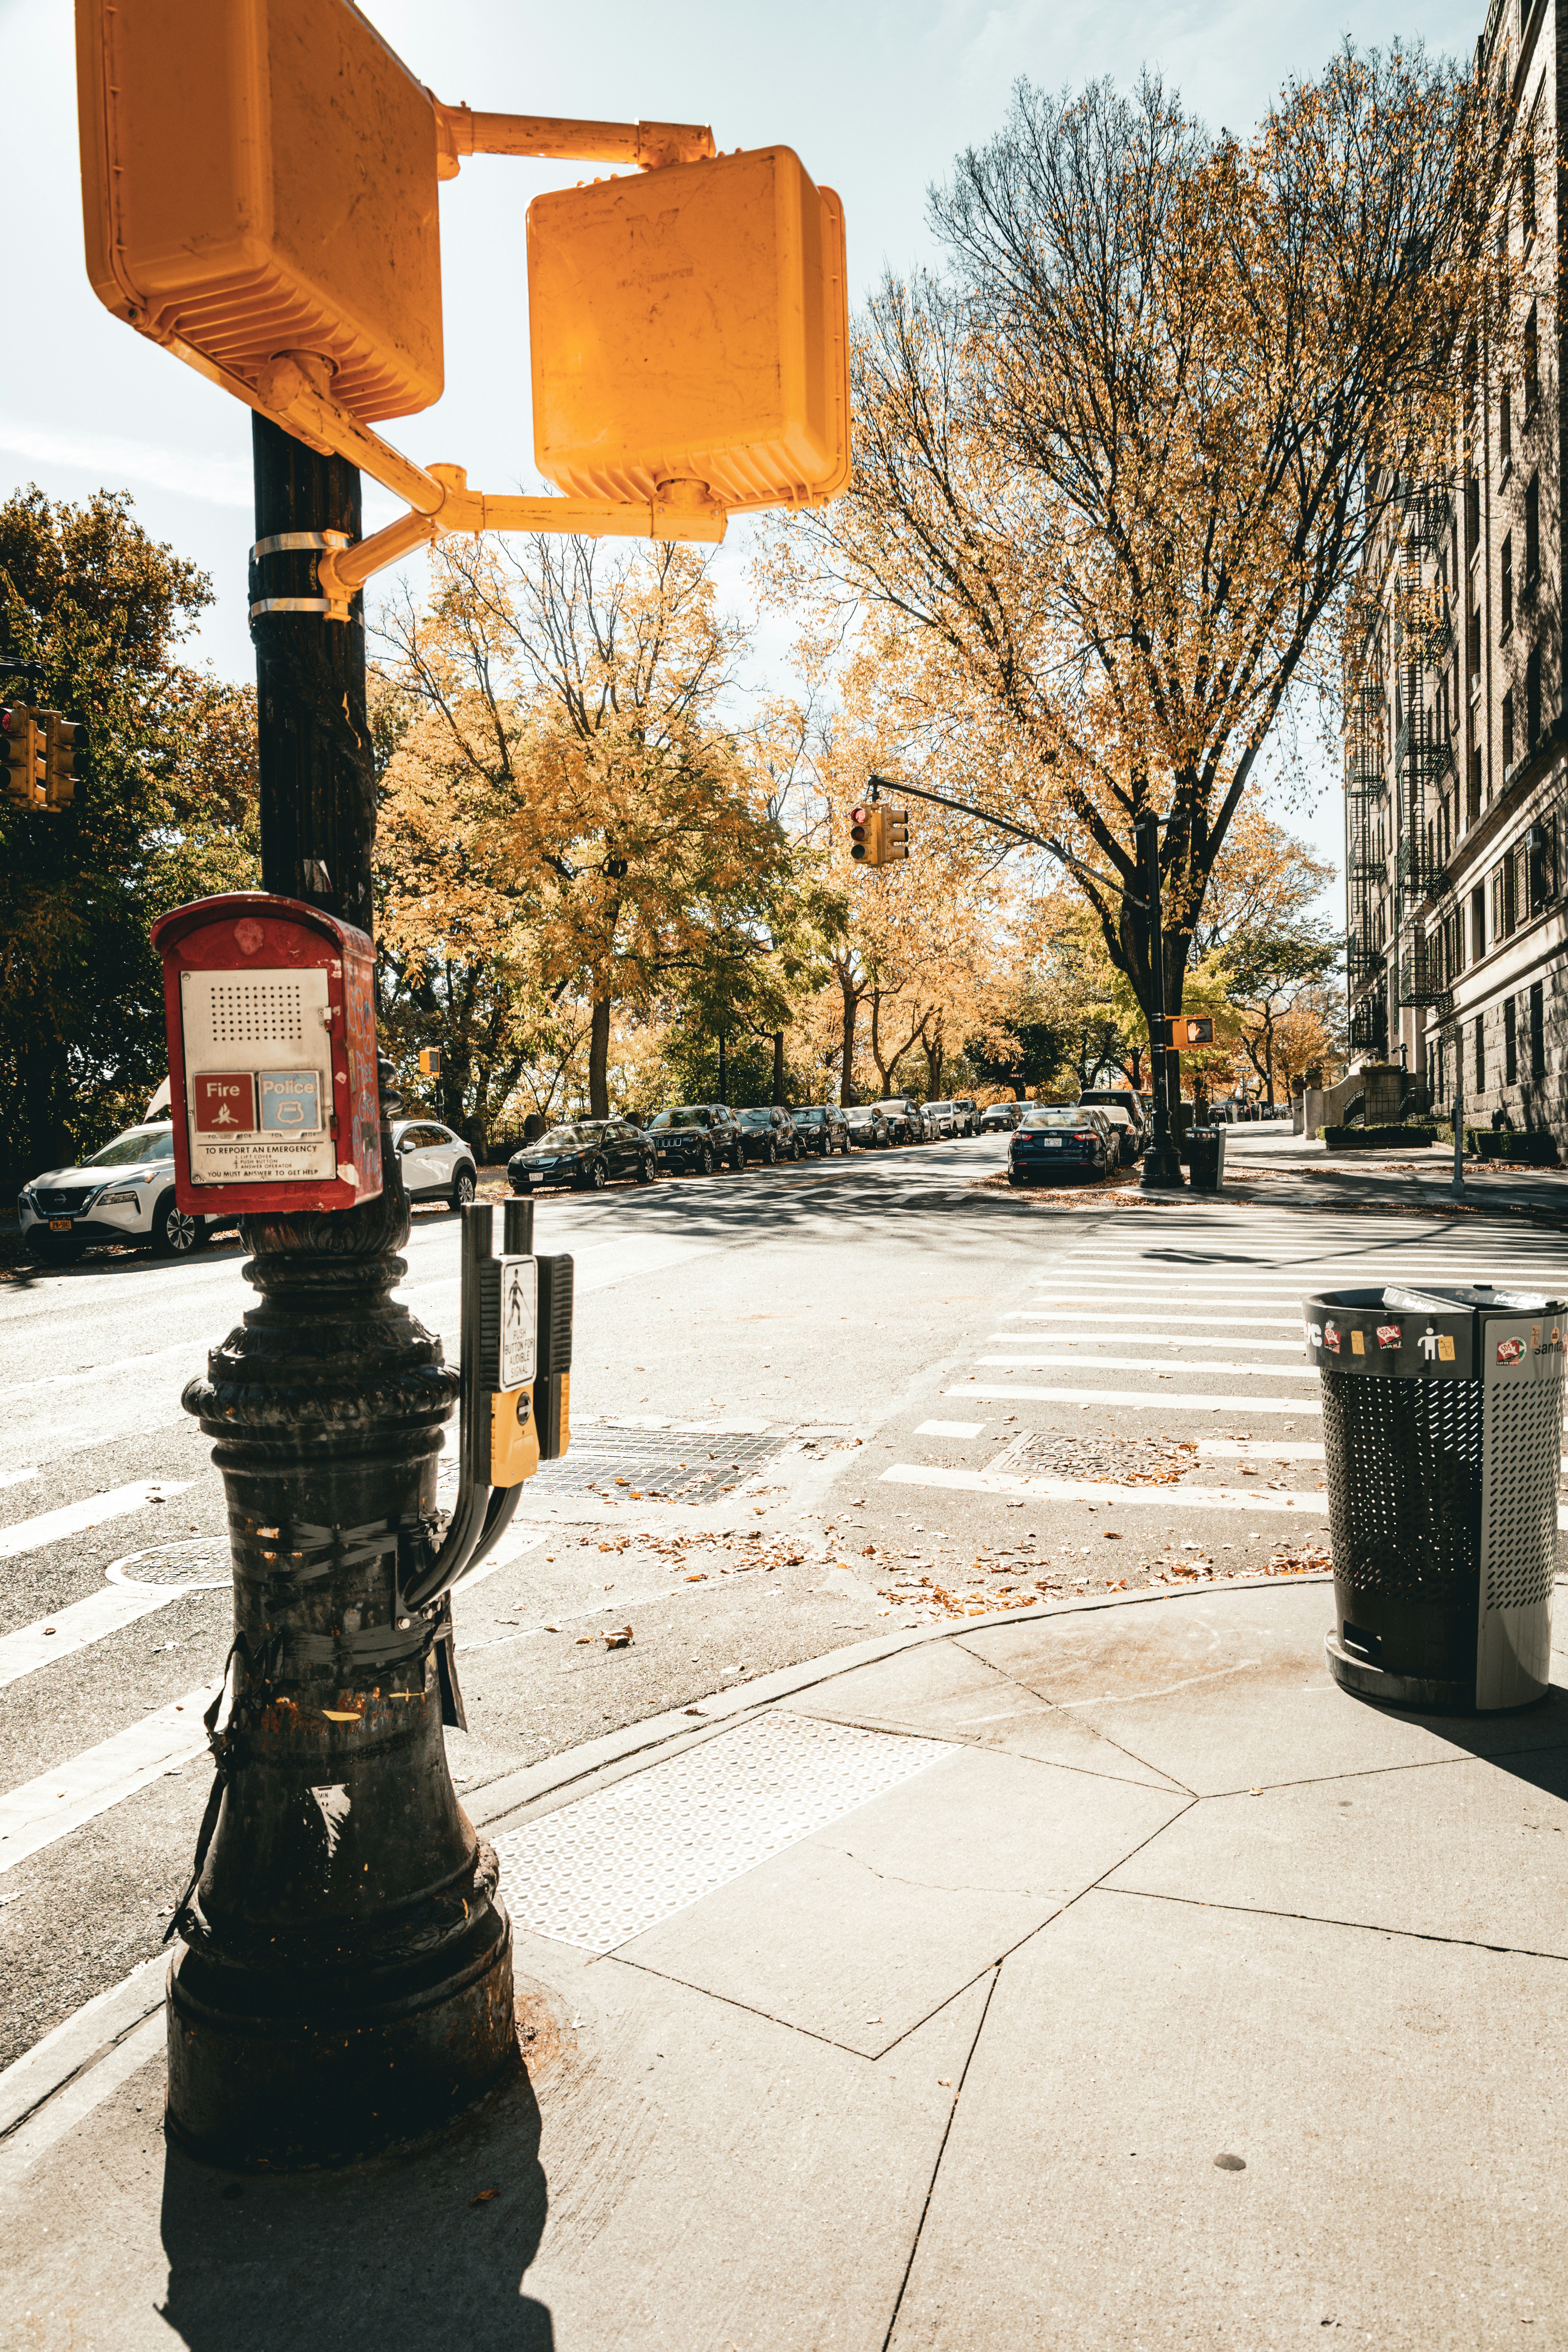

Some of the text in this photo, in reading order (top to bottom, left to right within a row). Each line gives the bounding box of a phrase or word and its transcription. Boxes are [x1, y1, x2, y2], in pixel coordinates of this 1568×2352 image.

[207, 1083, 240, 1097] Fire
[262, 1080, 315, 1095] Police
[513, 1328, 526, 1340] PUSH
[1379, 1328, 1391, 1337] SDS
[505, 1338, 534, 1355] BUTTON FOR
[1501, 1344, 1511, 1353] SDS
[509, 1351, 529, 1366] AUDIBLE
[511, 1364, 527, 1378] SIGNAL
